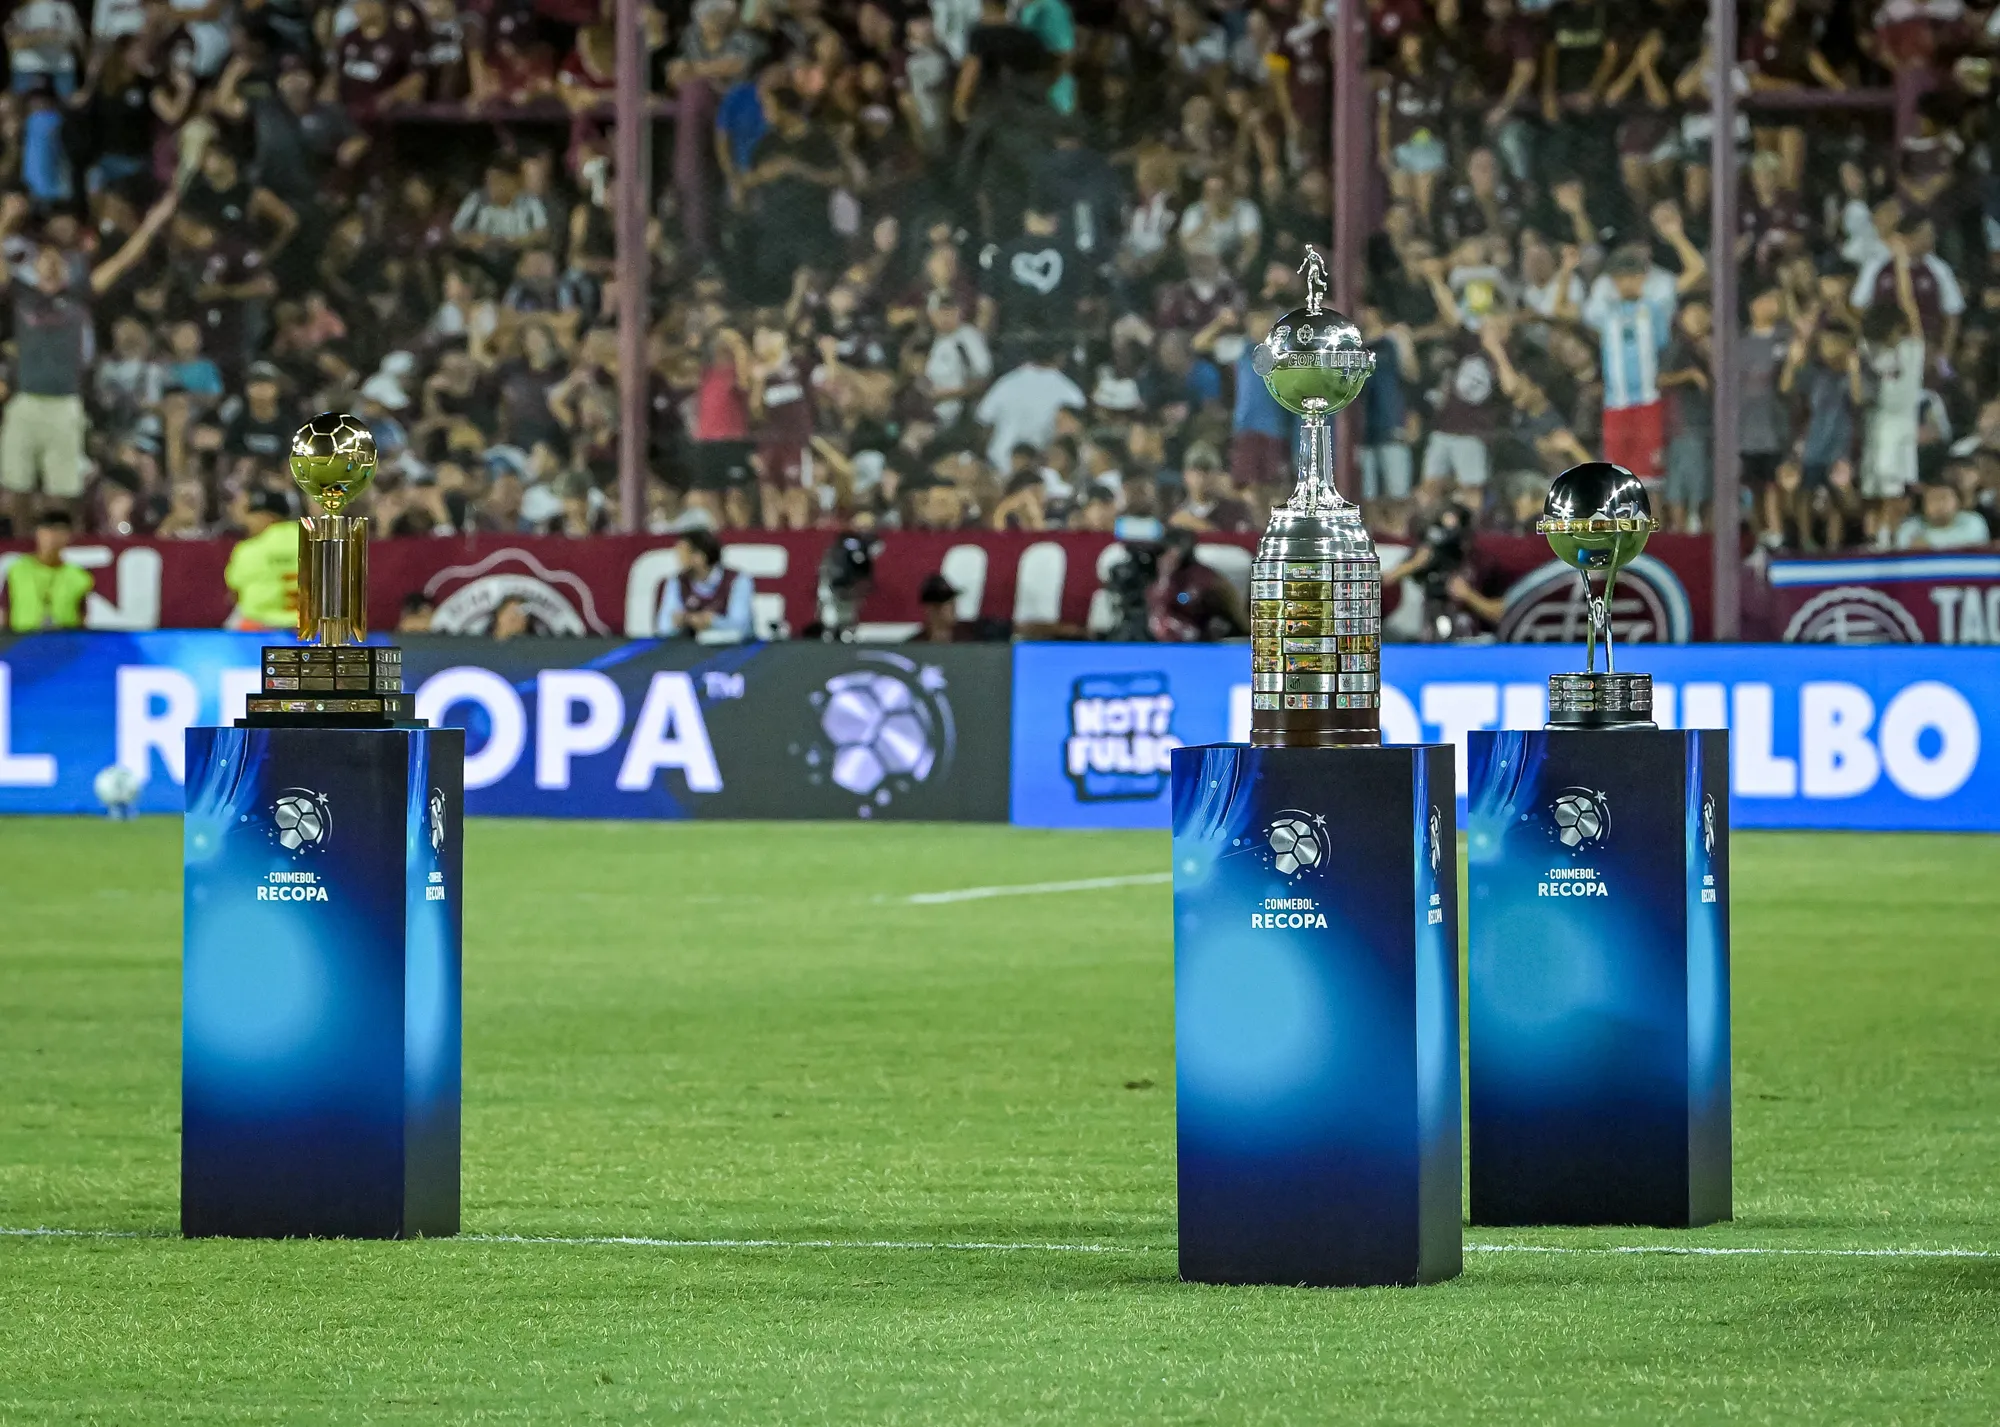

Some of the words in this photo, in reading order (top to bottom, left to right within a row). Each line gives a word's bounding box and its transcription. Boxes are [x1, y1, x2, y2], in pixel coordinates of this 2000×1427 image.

[1288, 353, 1324, 367] COPA
[256, 886, 329, 902] RECOPA
[1538, 882, 1609, 897] RECOPA
[1251, 913, 1329, 929] RECOPA
